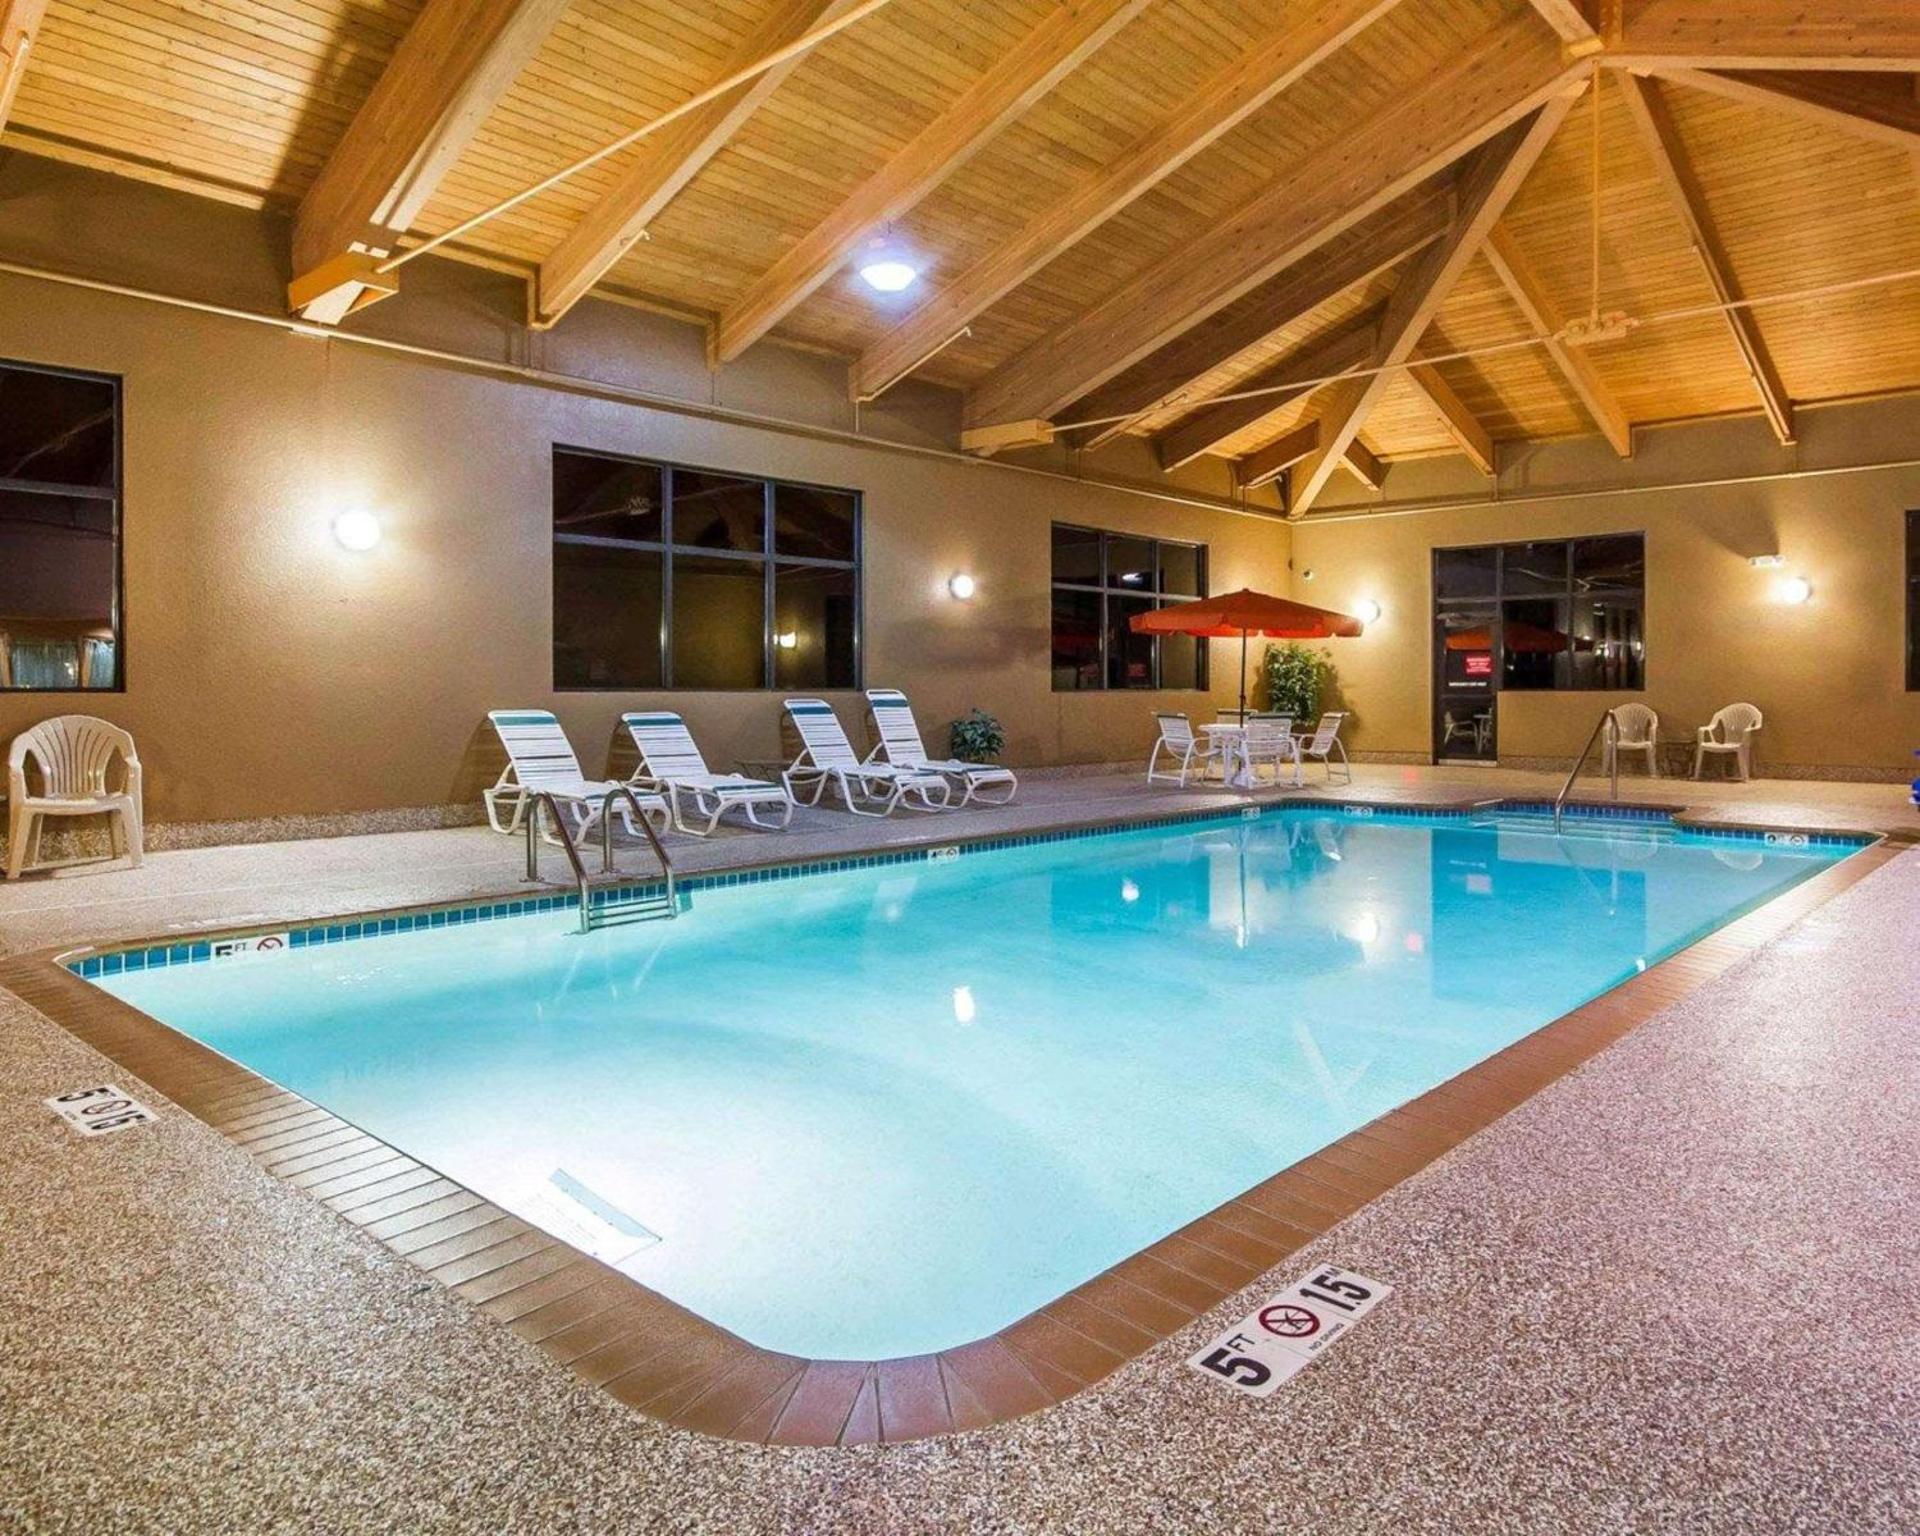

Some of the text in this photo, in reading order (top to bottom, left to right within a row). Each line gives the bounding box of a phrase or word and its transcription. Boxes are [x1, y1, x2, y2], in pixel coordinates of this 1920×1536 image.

[1308, 1323, 1345, 1351] NO DIVING
[1200, 1333, 1271, 1387] 5 FT
